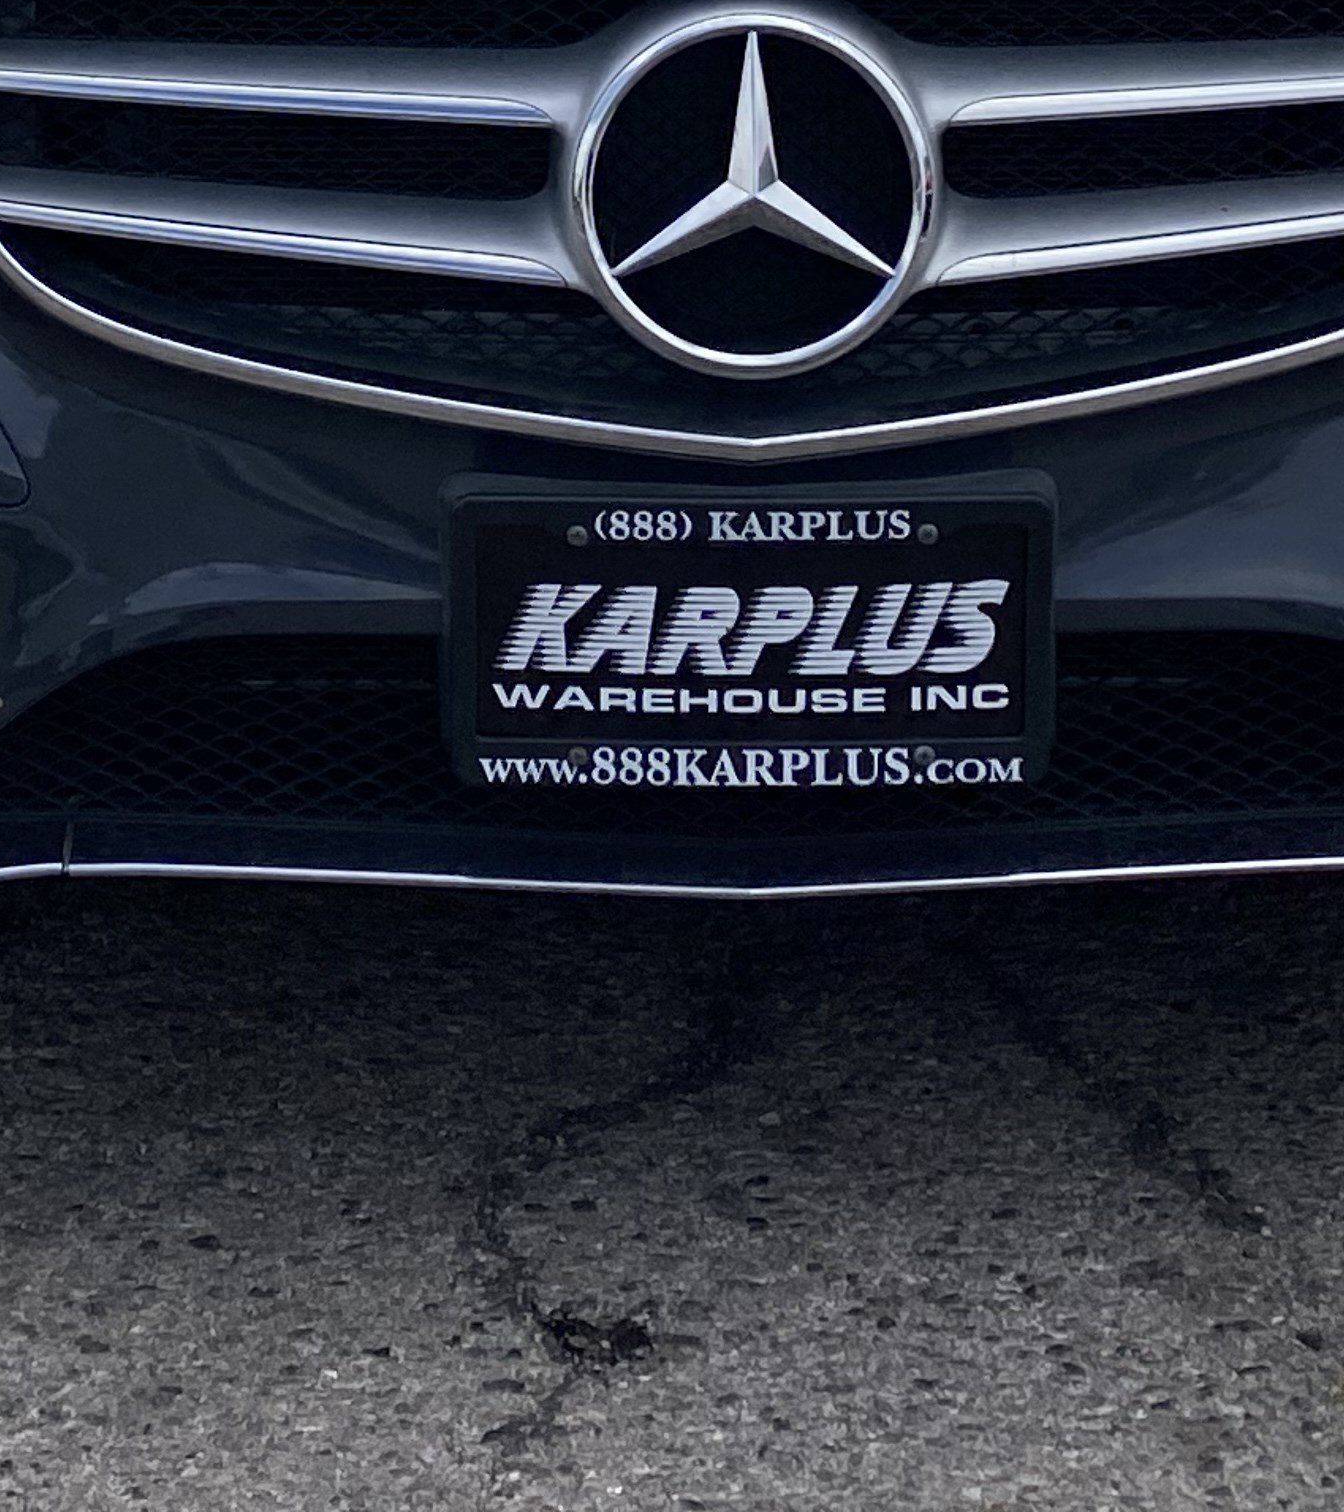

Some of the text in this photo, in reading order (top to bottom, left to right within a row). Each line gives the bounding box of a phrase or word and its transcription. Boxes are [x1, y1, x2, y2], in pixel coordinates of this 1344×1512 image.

[594, 509, 911, 541] (888) KARPLUS
[493, 579, 1010, 676] KARPLUS
[493, 684, 1010, 714] WAREHOUSE INC
